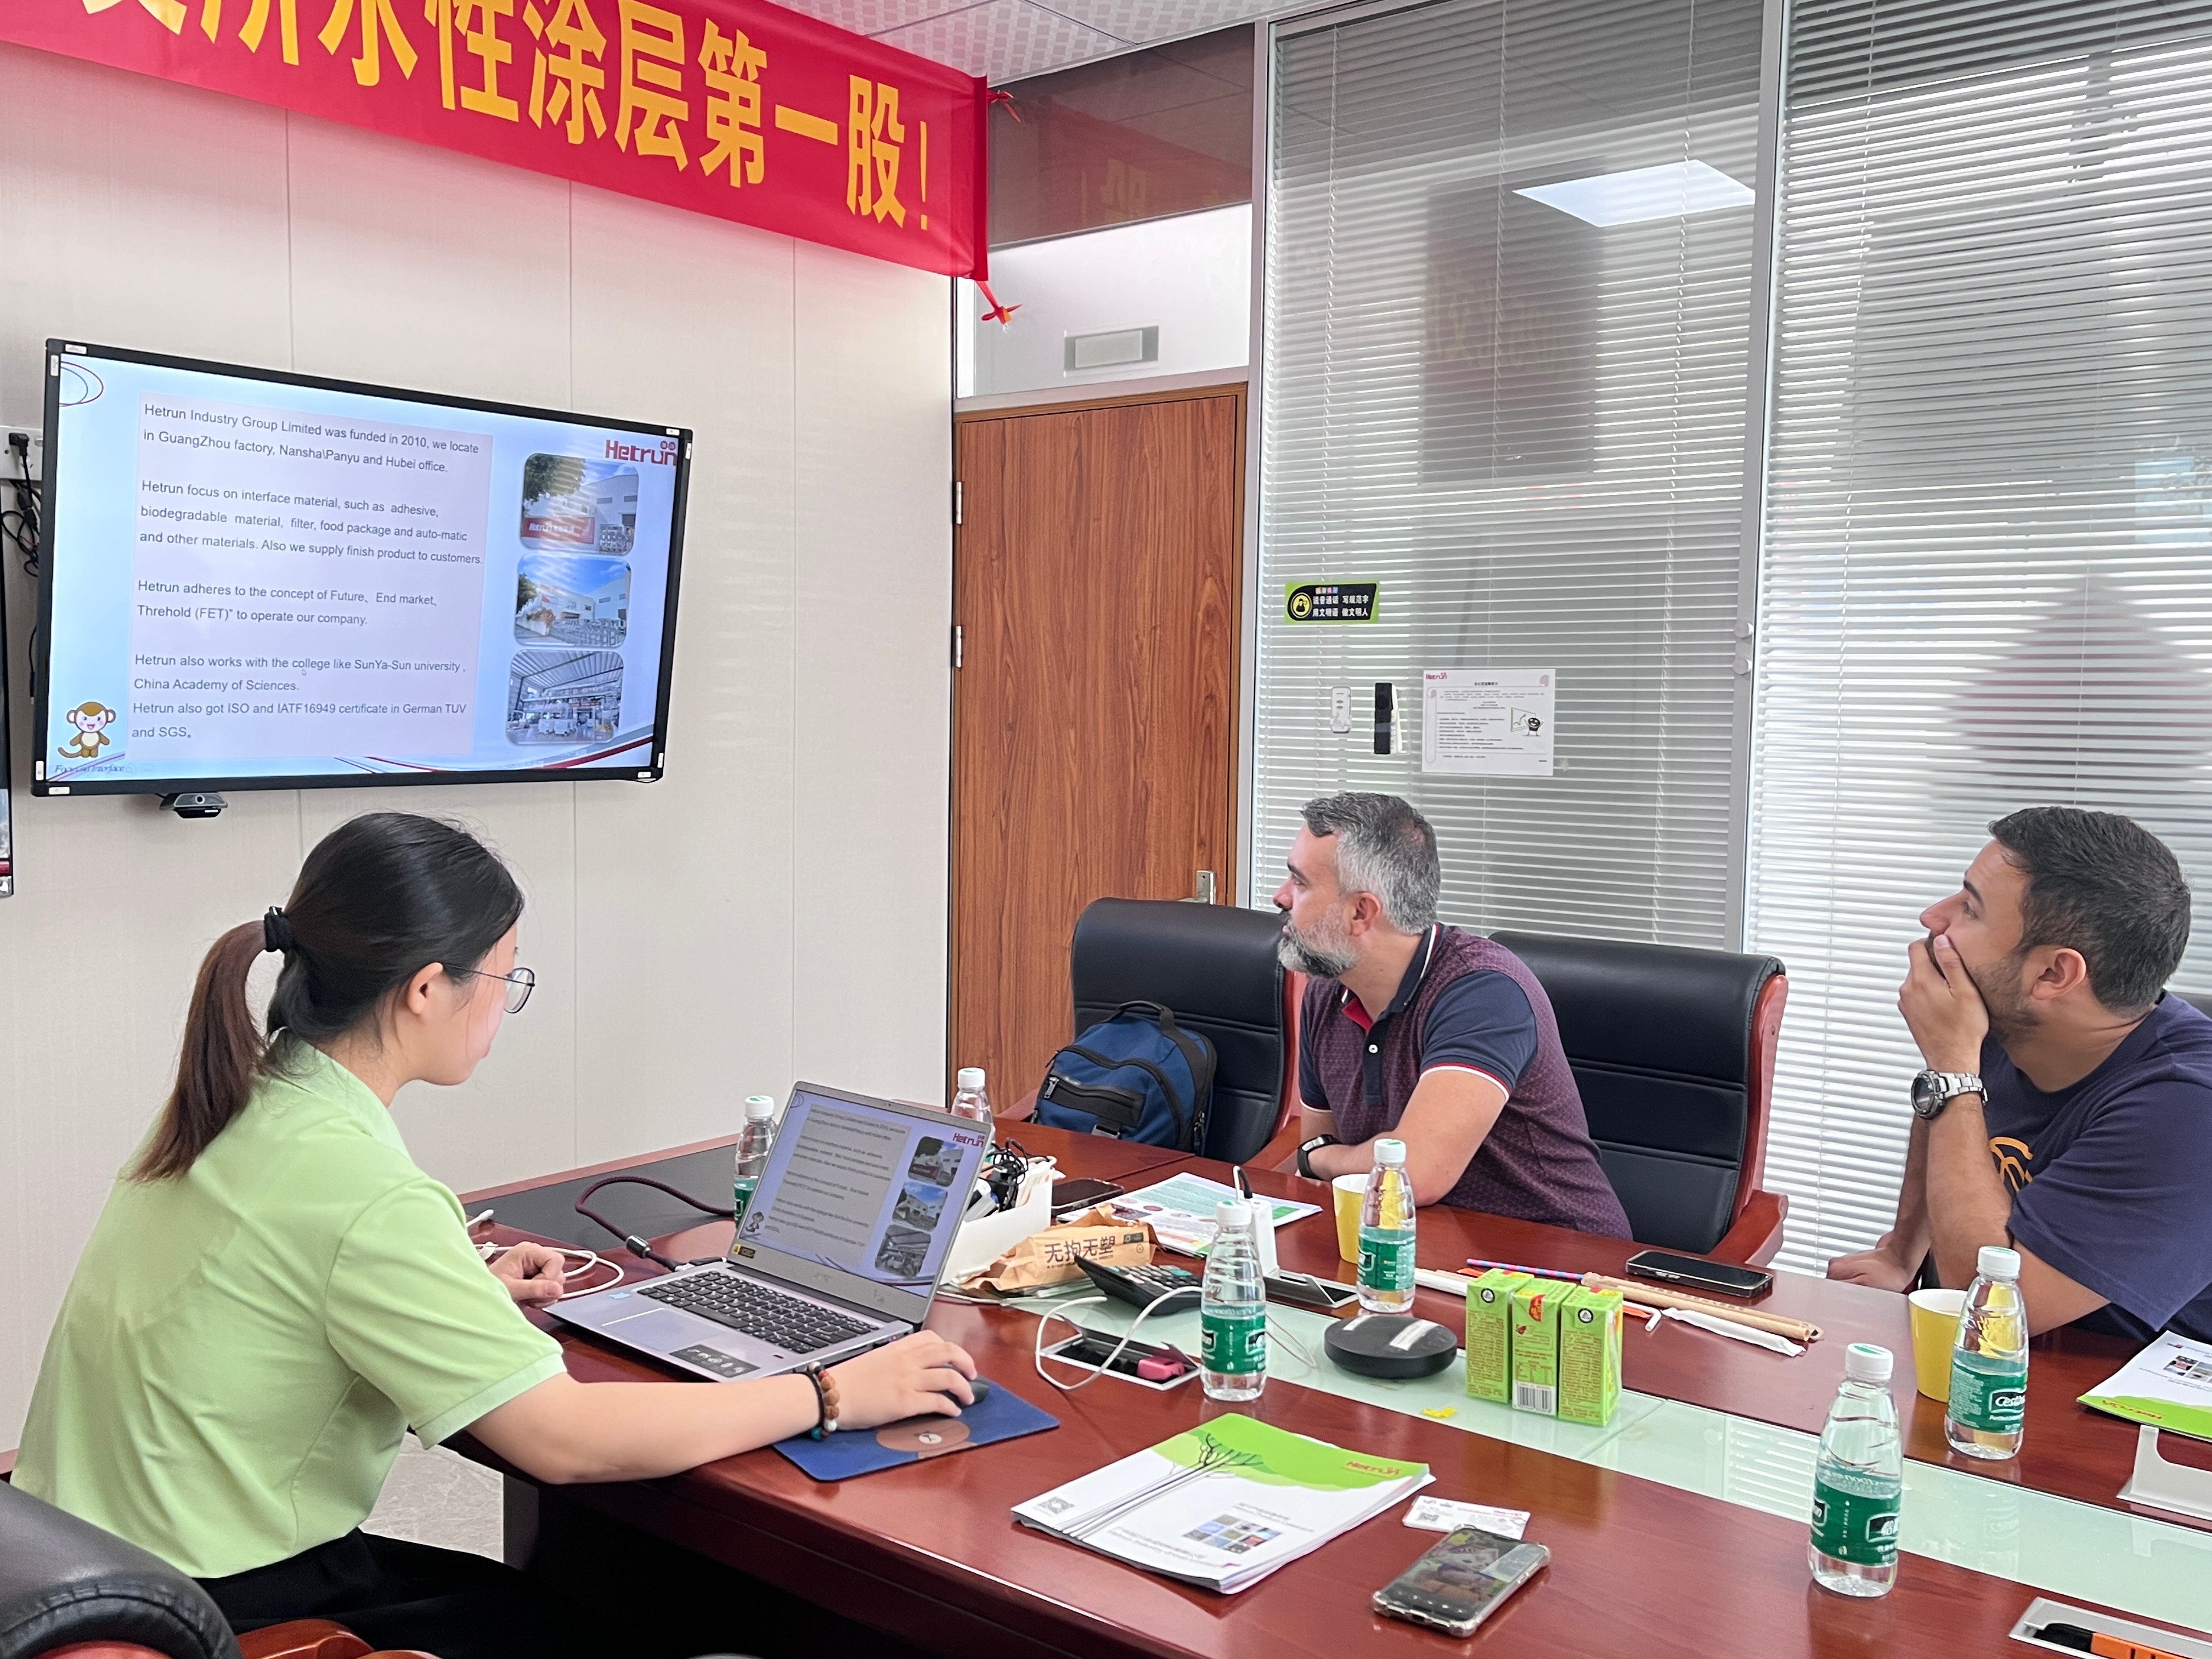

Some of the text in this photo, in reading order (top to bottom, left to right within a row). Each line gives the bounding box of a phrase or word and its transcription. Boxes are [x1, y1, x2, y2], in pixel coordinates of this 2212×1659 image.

[144, 403, 479, 454] Hetrun Industry Group Limited was funded in 2010, we locate
[143, 428, 154, 441] in
[159, 431, 230, 449] GuangZhou
[234, 439, 275, 456] factory,
[363, 455, 383, 466] and
[386, 455, 416, 469] Hubei
[418, 460, 448, 472] office.
[142, 479, 439, 518] Hetrun focus on interface material, such as adhesive,
[140, 505, 467, 541] biodegradable material, filter, food package and auto-matic
[139, 532, 483, 564] and other materials. Also we supply finish product to customers.
[138, 579, 179, 593] Hetrun
[183, 583, 232, 595] adheres
[235, 586, 246, 596] to
[249, 586, 267, 597] the
[270, 589, 314, 601] concept
[317, 589, 328, 600] of
[376, 592, 397, 603] End
[137, 605, 191, 618] Threhold
[236, 610, 247, 620] to
[251, 612, 294, 623] operate
[296, 614, 315, 622] our
[317, 614, 368, 627] company.
[135, 654, 176, 665] Hetrun
[179, 655, 205, 667] also
[207, 656, 242, 667] works
[245, 657, 268, 668] with
[272, 657, 289, 668] the
[292, 658, 331, 671] college
[333, 659, 352, 669] like
[354, 659, 411, 670] SunYa-Sun
[134, 678, 300, 693] China Academy of Sciences.
[133, 702, 174, 714] Hetrun
[177, 703, 202, 714] also
[205, 703, 224, 716] got
[228, 703, 250, 714] ISO
[252, 703, 274, 713] and
[277, 703, 336, 714] IATF16949
[338, 703, 388, 714] certificate
[403, 703, 442, 714] German
[445, 703, 467, 714] TUV
[131, 726, 155, 738] and
